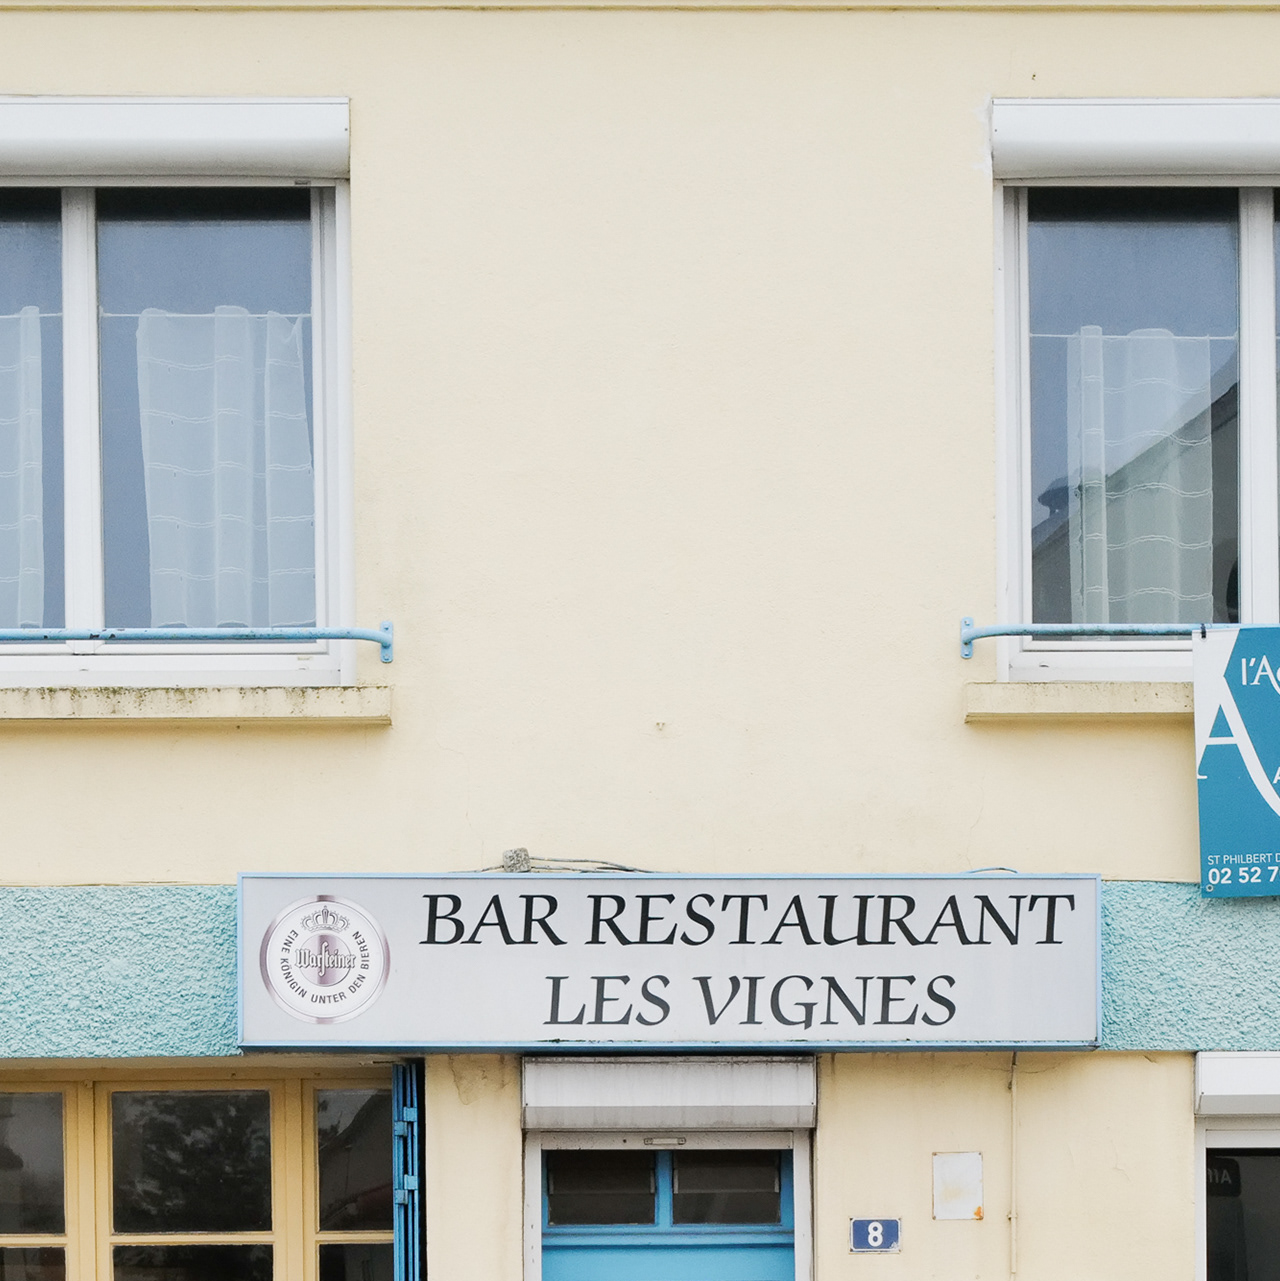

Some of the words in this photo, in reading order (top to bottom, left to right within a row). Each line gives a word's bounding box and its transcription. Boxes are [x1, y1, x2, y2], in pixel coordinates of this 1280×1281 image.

[1207, 855, 1222, 866] ST
[1223, 853, 1273, 865] PHILBERT
[1208, 867, 1232, 886] 02
[1238, 866, 1262, 884] 52
[419, 893, 568, 945] BAR
[585, 893, 1076, 946] RESTAURANT
[281, 929, 299, 954] EINE
[352, 931, 370, 970] BIEREN
[280, 958, 308, 998] KÖNIGIN
[348, 973, 366, 993] DEN
[311, 991, 347, 1004] UNTER
[543, 974, 672, 1027] LES
[692, 974, 958, 1030] VIGNES
[867, 1221, 883, 1247] 8
